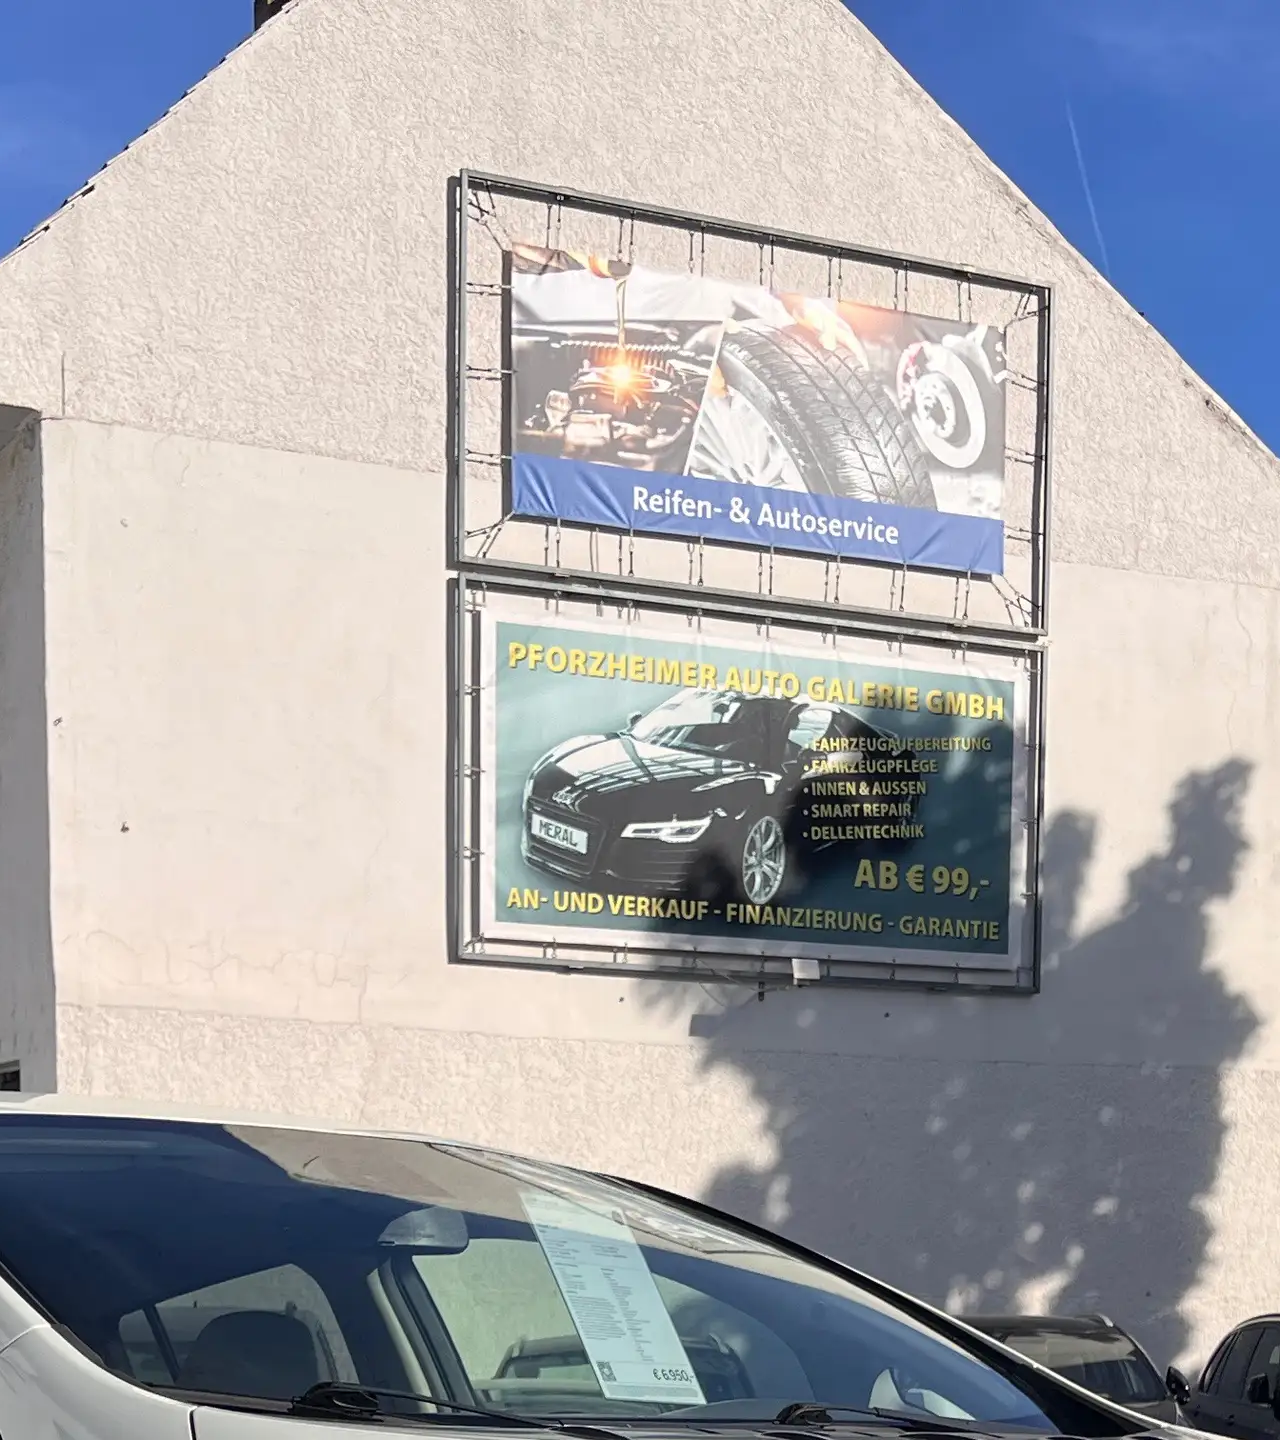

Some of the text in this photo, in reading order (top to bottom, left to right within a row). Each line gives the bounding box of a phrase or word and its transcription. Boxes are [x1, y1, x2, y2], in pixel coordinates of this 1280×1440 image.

[633, 486, 899, 545] Reifen- & Autoservice
[508, 641, 1005, 721] PFORZHEIMER AUTO GALERIE GMBH
[812, 736, 991, 753] FAHRZEUGAUFBEREITUNG
[811, 759, 938, 773] FAHRZEUGPFLEGE
[811, 781, 927, 796] INNEN & AUSSEN
[811, 803, 912, 818] SMART REPAIR
[539, 819, 578, 847] MERAL
[811, 825, 924, 840] DELLENTECHNIK
[854, 859, 990, 901] AB € 99,-
[507, 888, 548, 910] AN-
[553, 890, 604, 914] UND
[608, 894, 709, 921] VERKAUF
[726, 903, 883, 933] FINANZIERUNG
[899, 916, 1000, 940] GARANTIE
